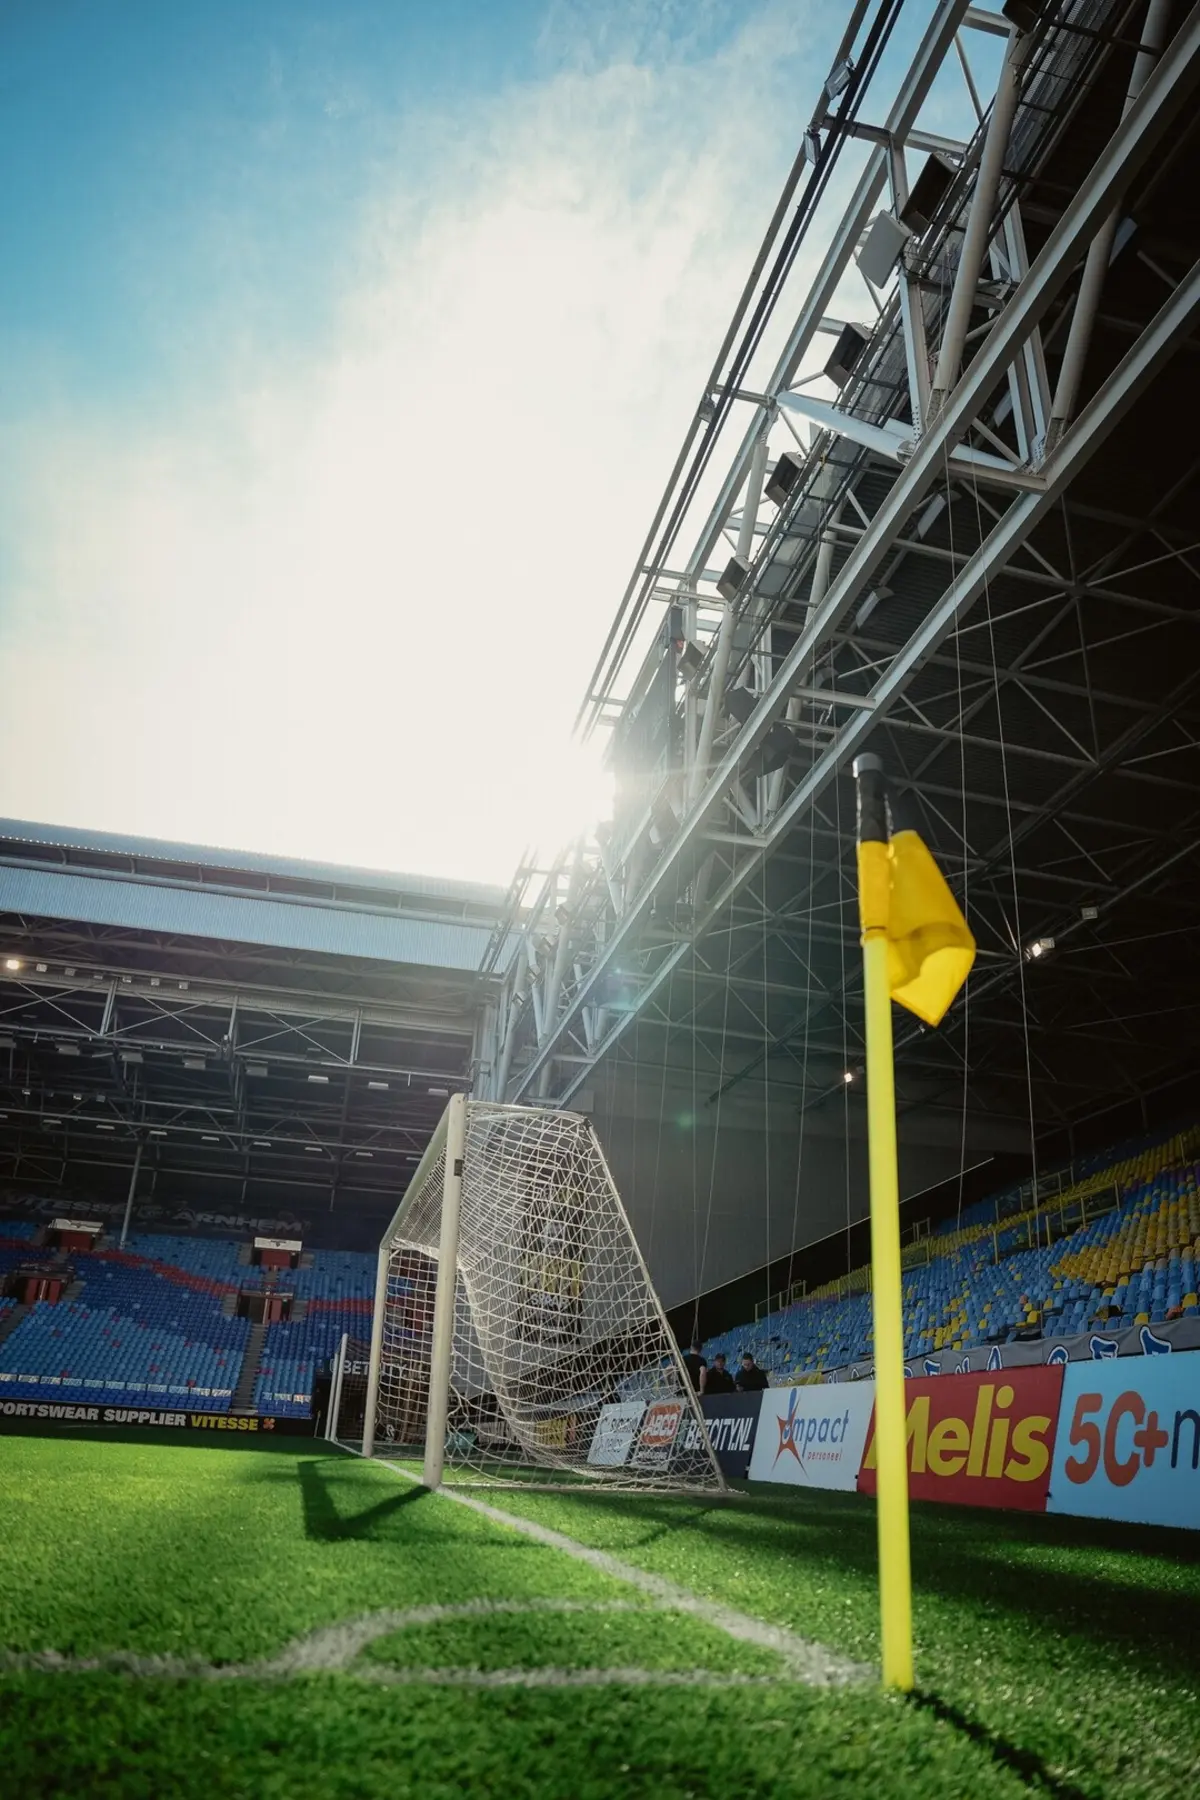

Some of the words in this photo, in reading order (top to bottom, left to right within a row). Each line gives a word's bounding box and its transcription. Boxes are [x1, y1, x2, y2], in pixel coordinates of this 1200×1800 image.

[172, 1208, 303, 1233] ARNHEM
[104, 1410, 186, 1427] SUPPLIER
[191, 1415, 259, 1431] VITESSE
[863, 1384, 1051, 1482] Melis
[807, 1447, 843, 1461] personeel
